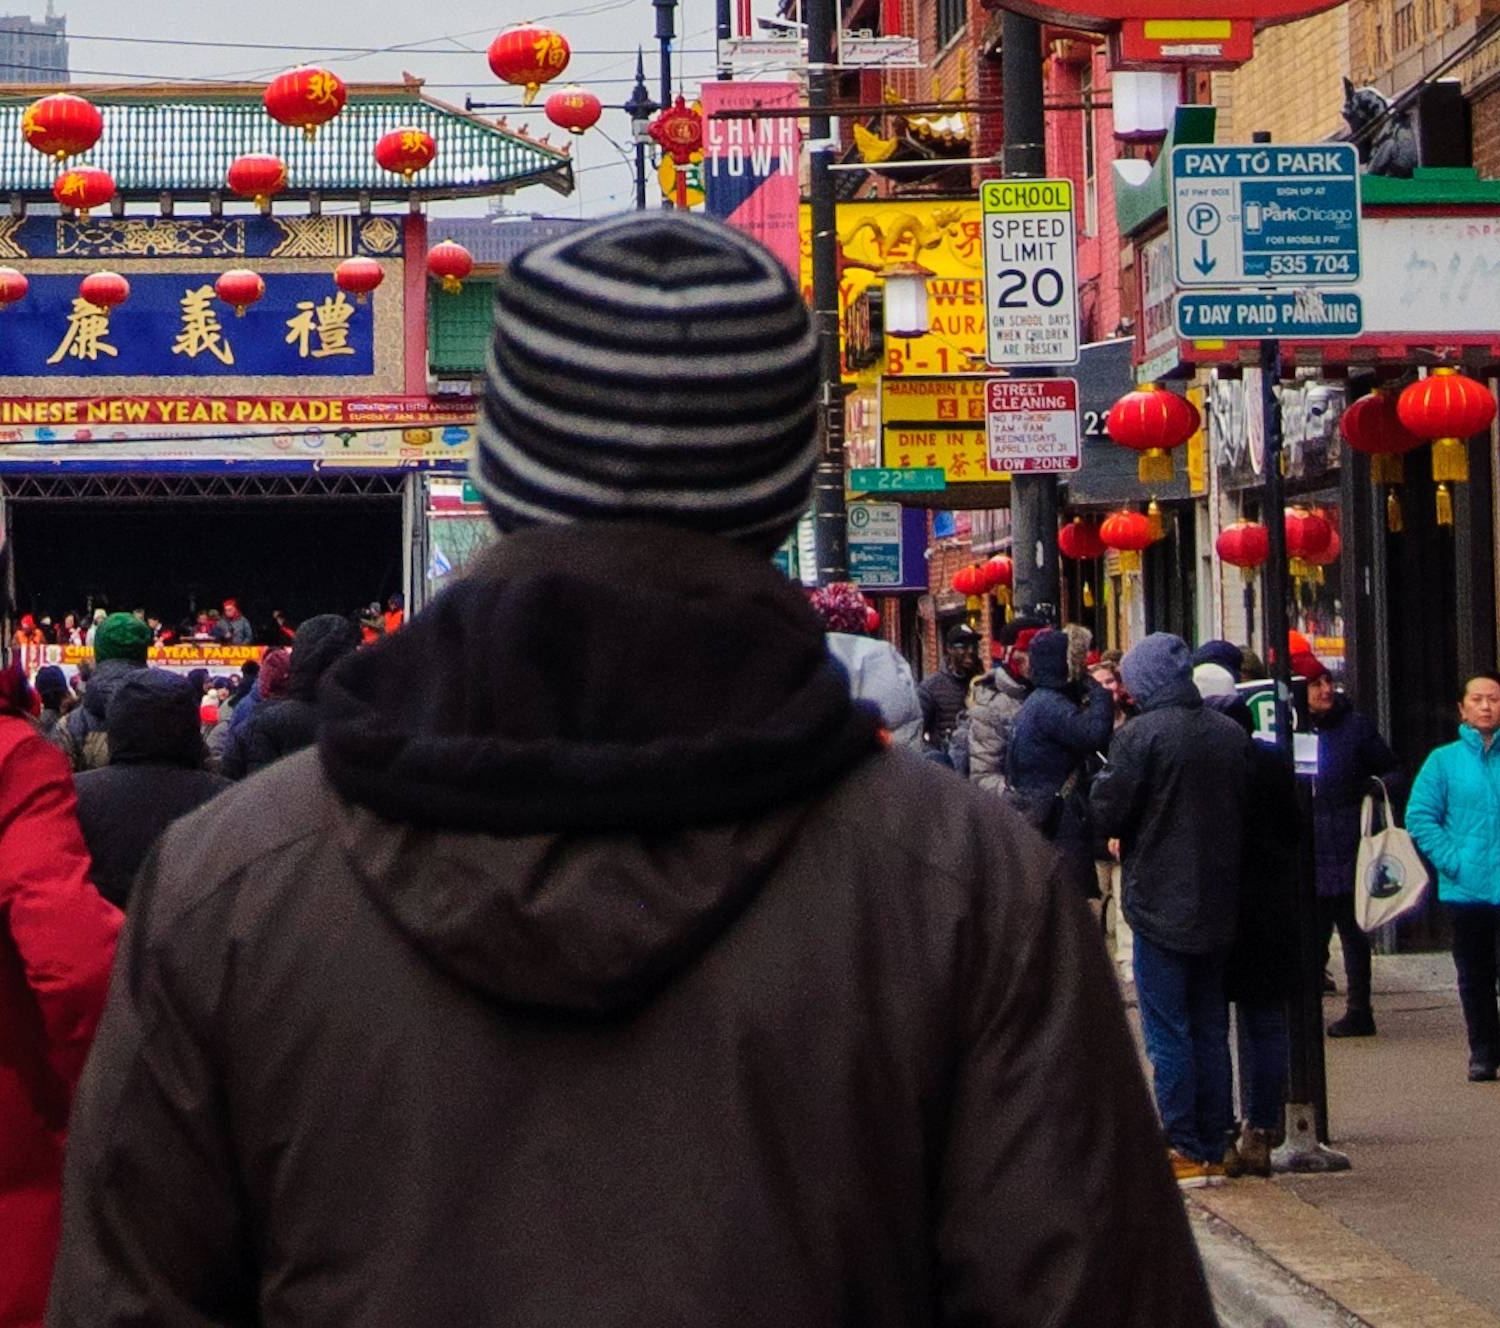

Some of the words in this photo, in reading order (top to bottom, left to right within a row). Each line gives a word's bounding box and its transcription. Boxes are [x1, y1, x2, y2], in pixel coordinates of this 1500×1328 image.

[709, 145, 793, 177] TOWN
[1185, 154, 1230, 174] PAY
[1236, 153, 1270, 174] TO
[1276, 152, 1343, 173] PARK
[988, 187, 1067, 208] SCHOOL
[1262, 207, 1352, 224] ParkChicago
[991, 218, 1066, 240] SPEED
[999, 242, 1057, 263] LIMIT
[1270, 255, 1307, 274] 535
[1313, 254, 1350, 273] 704
[996, 267, 1065, 309] 20
[992, 314, 1006, 328] ON
[1009, 315, 1044, 327] SCHOOL
[1048, 313, 1072, 326] DAYS
[1183, 305, 1194, 324] 7
[1199, 304, 1231, 324] DAY
[1236, 304, 1277, 324] PAID
[996, 330, 1022, 342] WHEN
[1025, 329, 1069, 342] CHILDREN
[1002, 344, 1022, 356] ARE
[1025, 343, 1064, 356] PRESENT
[992, 383, 1045, 397] STREET
[86, 401, 150, 423] NEW
[156, 400, 230, 423] YEAR
[237, 400, 343, 422] PARADE
[992, 397, 1067, 410] CLEANING
[898, 433, 937, 447] DINE
[947, 433, 964, 446] IN
[993, 434, 1057, 444] WEDNESDAYS
[994, 457, 1025, 471] TOW
[1032, 456, 1072, 470] ZONE
